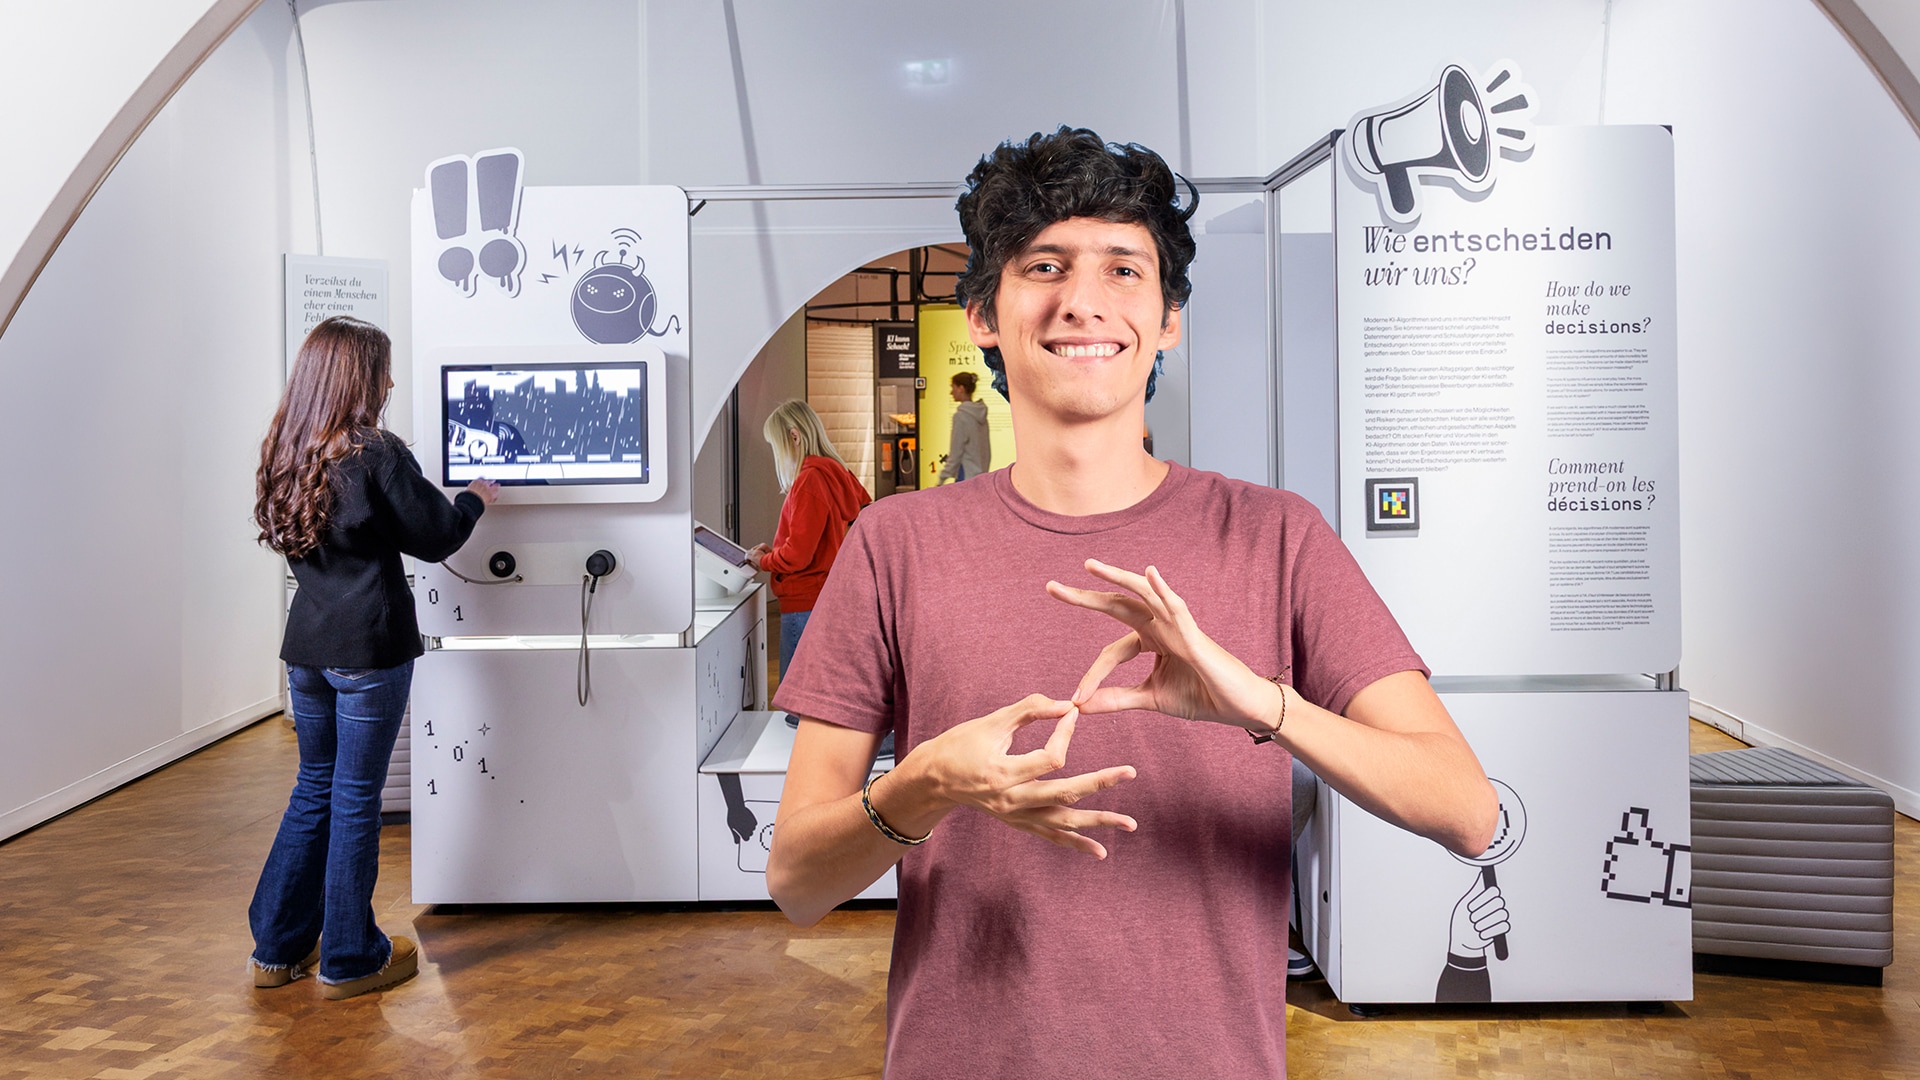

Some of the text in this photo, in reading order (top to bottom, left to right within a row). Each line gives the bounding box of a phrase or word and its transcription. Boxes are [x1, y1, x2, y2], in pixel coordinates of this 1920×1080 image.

[1362, 226, 1612, 253] Wie entscheiden
[1364, 257, 1477, 286] wir uns?
[304, 274, 362, 287] Verzeihst du
[304, 288, 377, 300] einem Menschen
[1546, 280, 1631, 298] How do we
[304, 300, 354, 311] eher einen
[1546, 300, 1590, 316] make
[1545, 316, 1652, 334] decisions?
[949, 355, 976, 366] mit!
[1548, 458, 1625, 474] Comment
[1548, 476, 1656, 497] prend-on les
[1547, 494, 1656, 512] décisions ?
[428, 588, 439, 604] 0
[453, 605, 464, 621] 1
[424, 720, 435, 736] 1
[453, 746, 463, 761] 0
[478, 757, 488, 773] 1
[427, 779, 438, 795] 1
